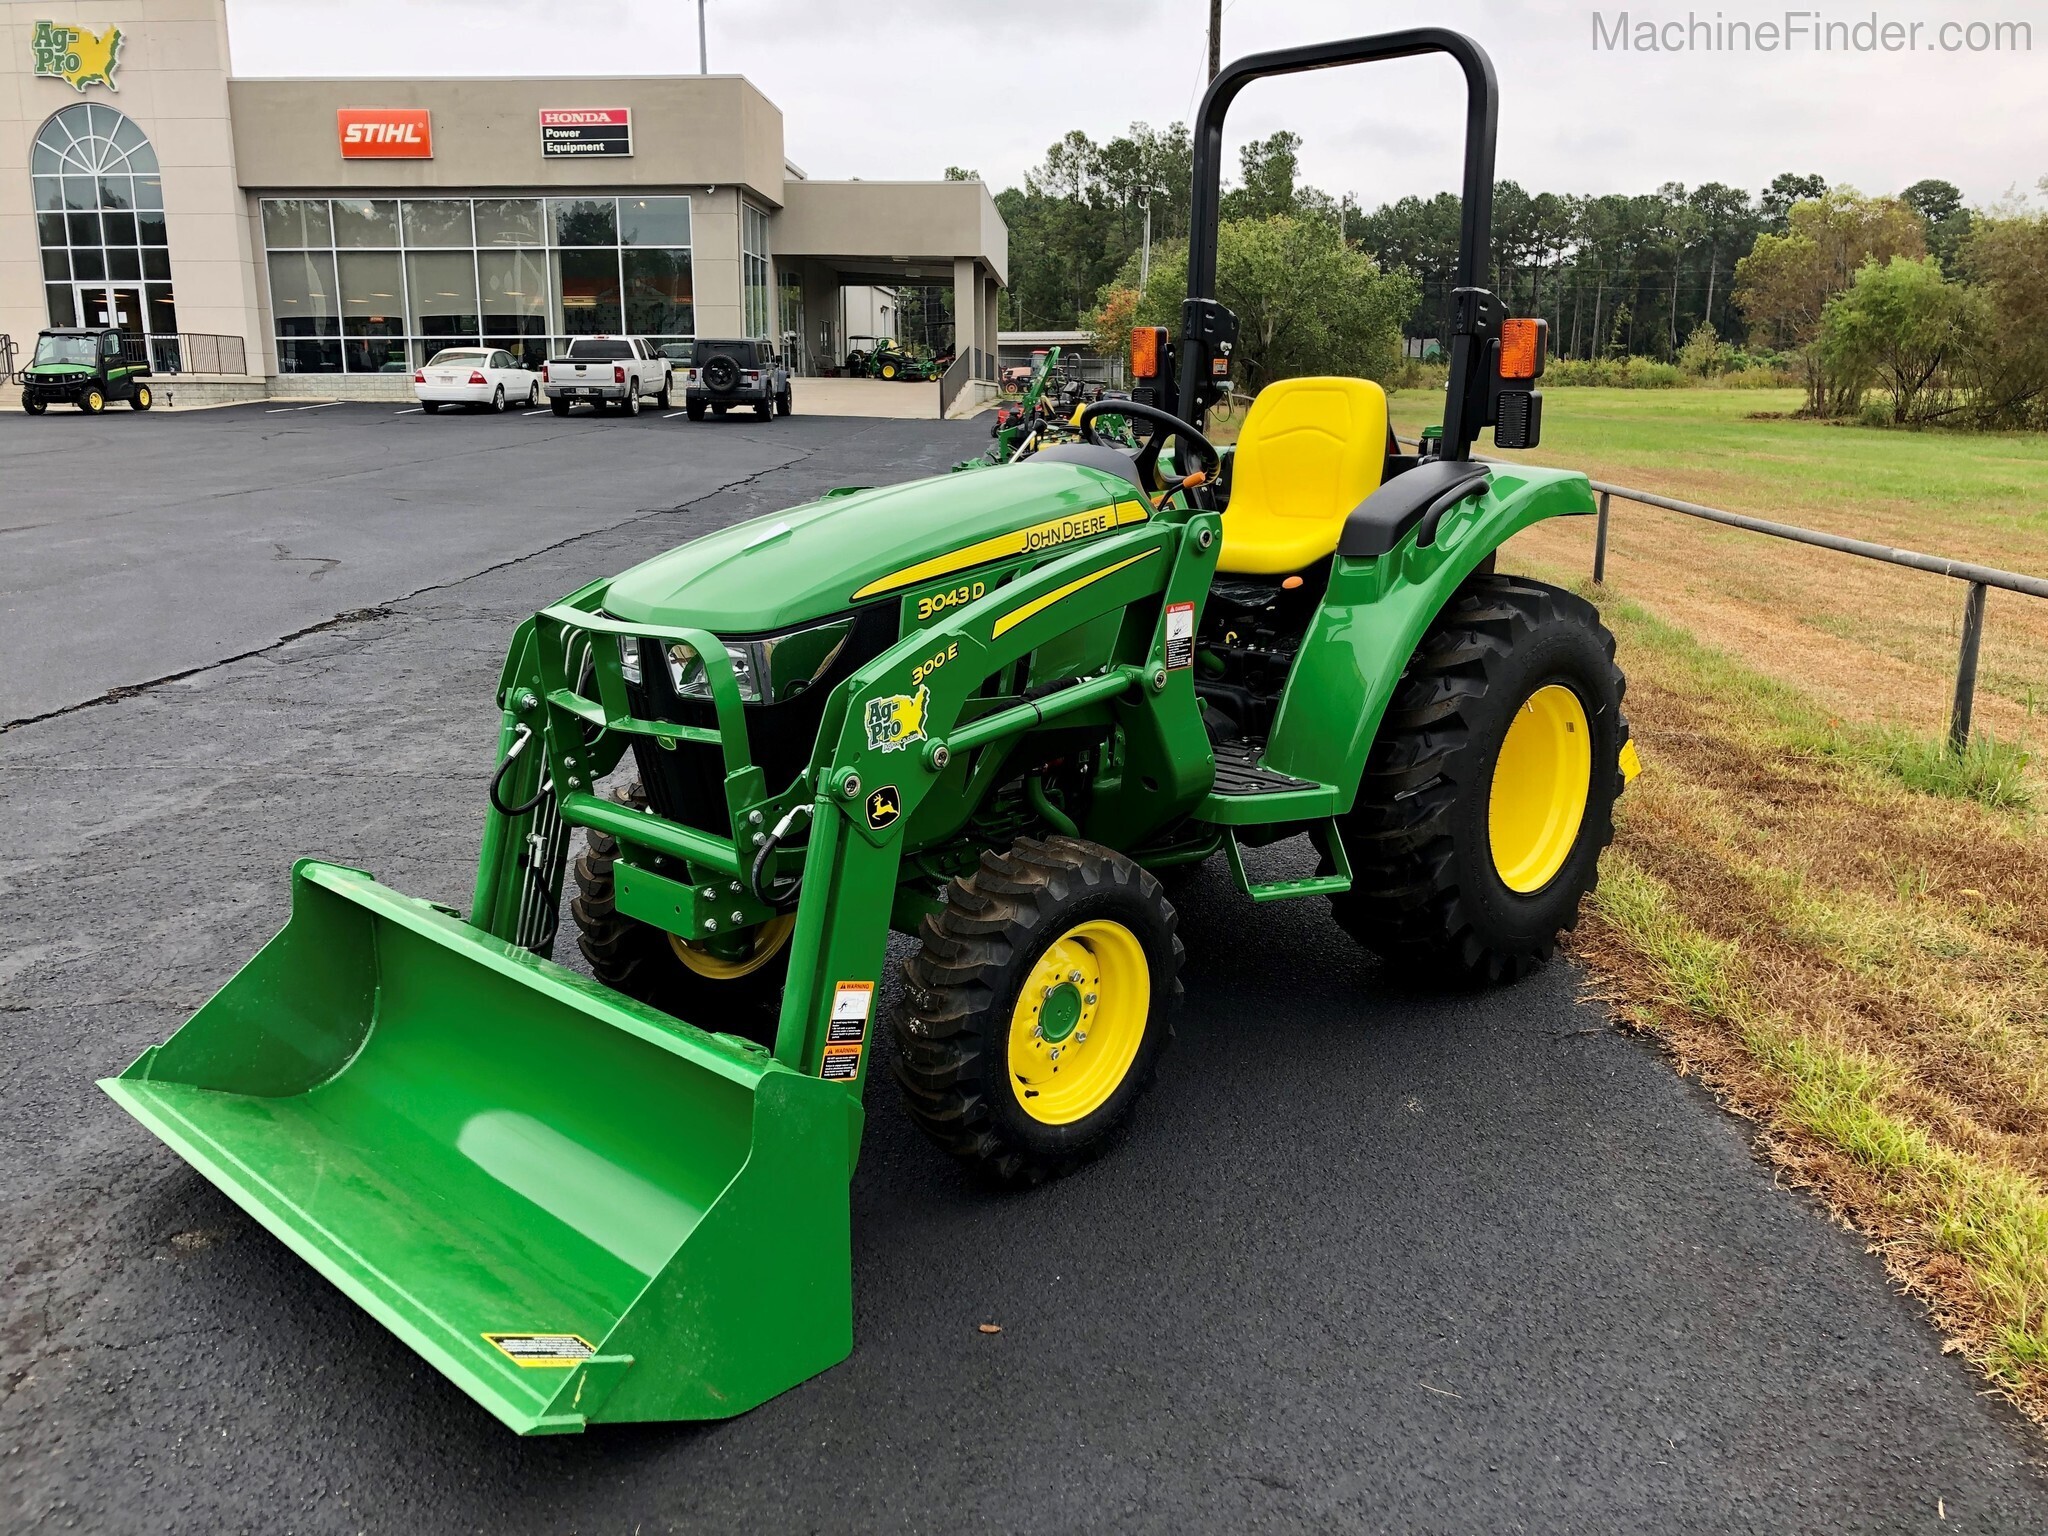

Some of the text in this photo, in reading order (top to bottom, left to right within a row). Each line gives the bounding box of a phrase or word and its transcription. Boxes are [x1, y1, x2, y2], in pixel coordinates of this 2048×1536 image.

[33, 22, 79, 52] Ag-
[34, 48, 81, 74] Pro
[544, 112, 612, 123] HONDA
[344, 123, 421, 143] STIHL
[545, 128, 580, 138] Power
[546, 142, 605, 154] Equipment
[1021, 515, 1107, 552] JOHN DEERE
[917, 581, 985, 620] 3043 D
[911, 642, 958, 686] 300 E
[868, 700, 900, 725] Ag-
[869, 719, 902, 747] Pro
